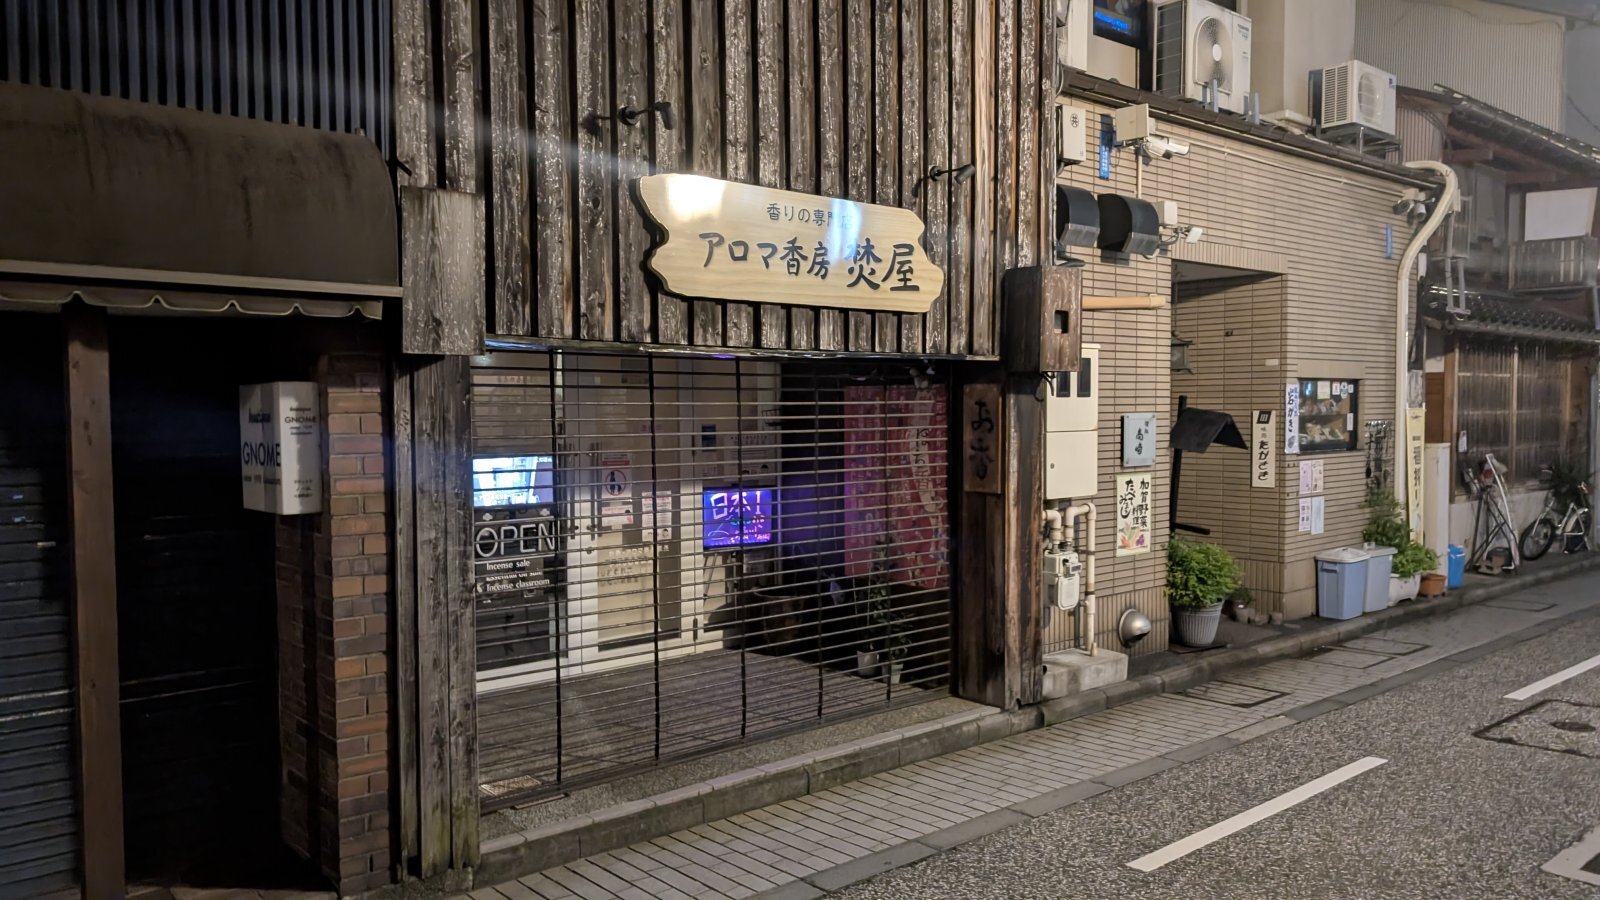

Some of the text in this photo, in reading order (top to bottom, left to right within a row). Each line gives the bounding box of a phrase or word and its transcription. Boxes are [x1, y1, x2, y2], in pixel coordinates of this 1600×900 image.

[699, 232, 920, 292] アロマ香房 焚屋
[243, 442, 281, 467] GNOME
[476, 523, 555, 557] OPEN
[486, 559, 531, 571] Incense sale
[486, 579, 550, 592] Incense classroom
